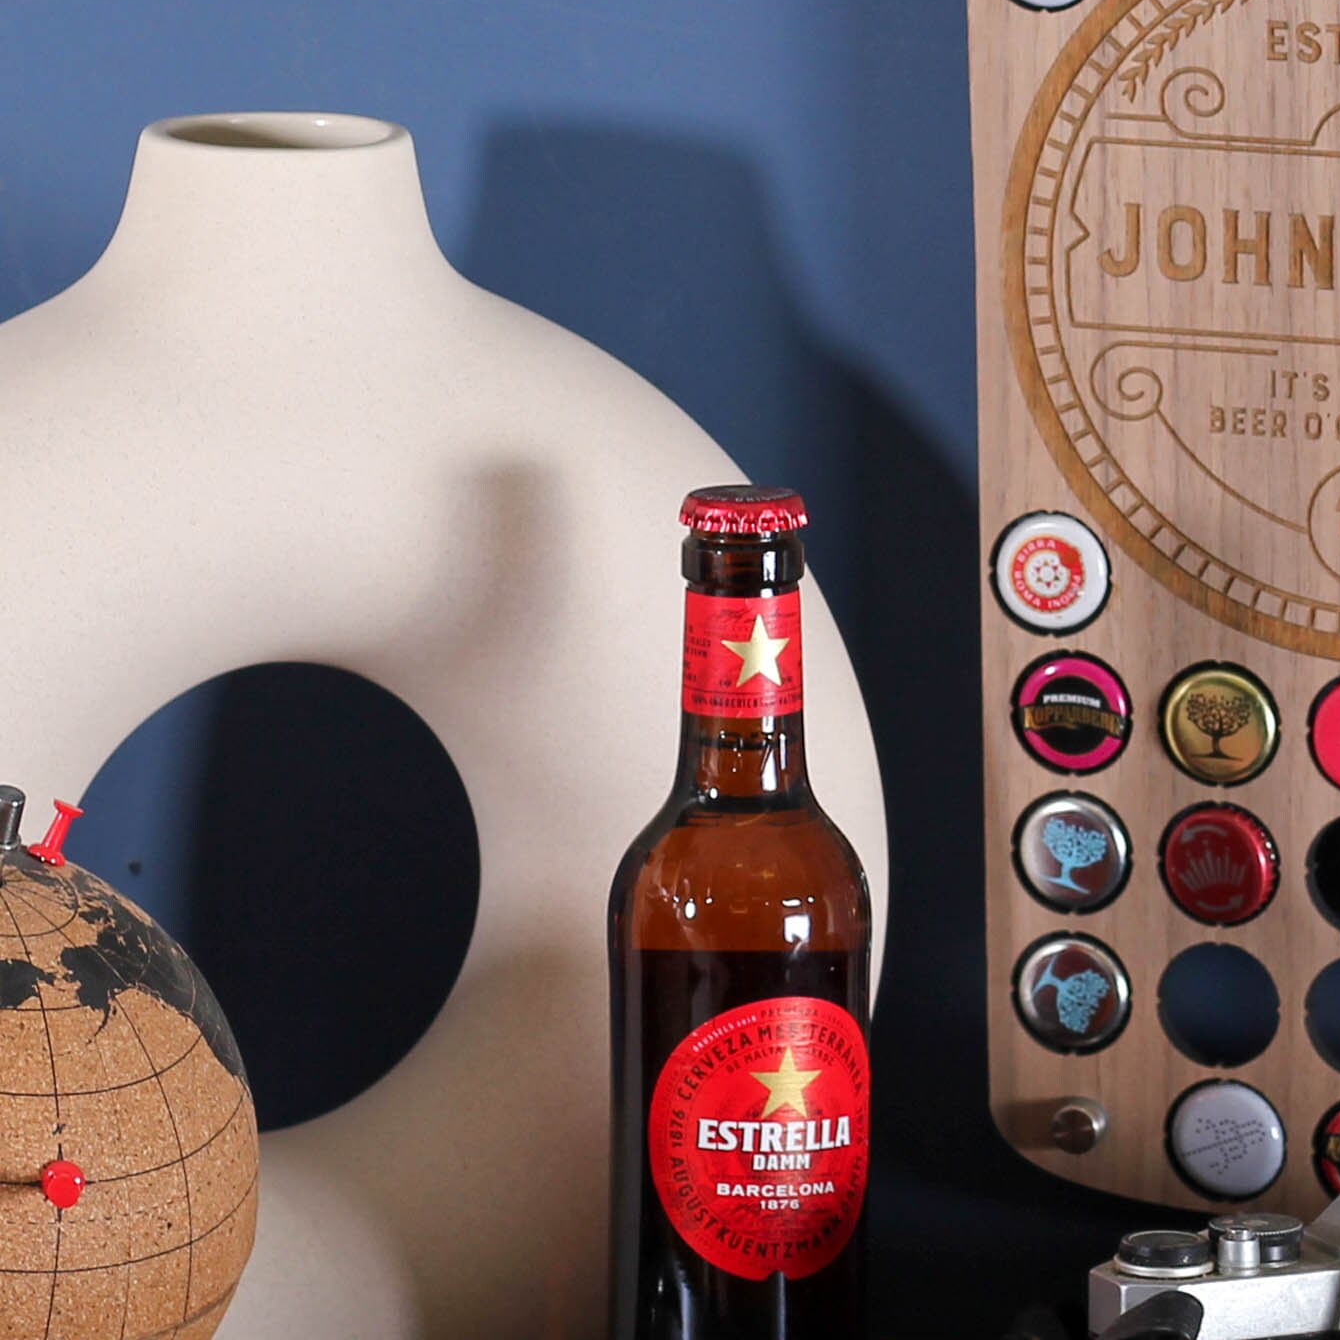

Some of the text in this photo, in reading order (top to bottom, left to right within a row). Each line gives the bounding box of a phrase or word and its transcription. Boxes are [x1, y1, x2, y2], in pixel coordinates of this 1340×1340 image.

[1270, 369, 1330, 402] IT'S
[1209, 405, 1288, 438] BEER
[1042, 693, 1101, 709] PREMIUM
[676, 1032, 753, 1100] CERVEZA
[697, 1116, 851, 1153] ESTRELLA
[752, 1153, 811, 1171] DAMM
[671, 1155, 718, 1230] AUGUST
[716, 1180, 835, 1198] BARCELONA
[759, 1198, 801, 1211] 1876
